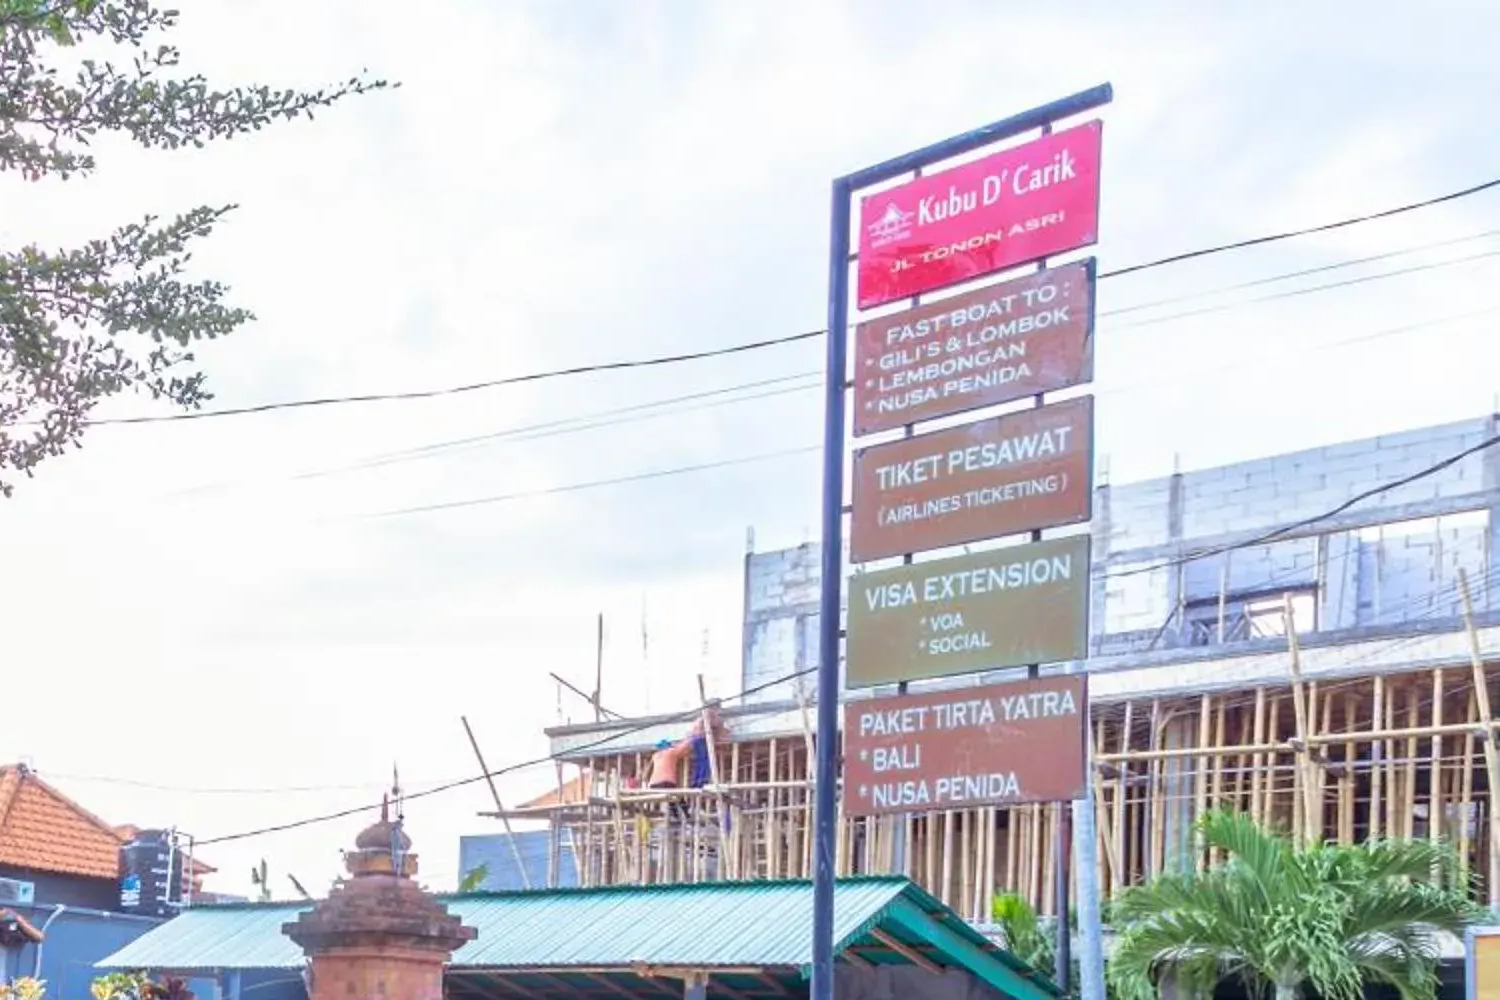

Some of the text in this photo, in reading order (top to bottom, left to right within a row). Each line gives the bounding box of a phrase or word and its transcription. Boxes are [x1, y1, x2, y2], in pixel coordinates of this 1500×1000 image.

[918, 186, 976, 227] Kubu
[1012, 150, 1076, 196] Carik
[921, 230, 1002, 264] TONON
[1007, 211, 1065, 237] ASRI
[879, 306, 1069, 369] GILI'S & LOMBOK
[887, 311, 950, 344] FAST
[951, 295, 1014, 327] BOAT
[879, 342, 1026, 392] LEMBONGAN
[879, 363, 1032, 413] NUSA PENIDA
[876, 427, 1070, 491] TIKET PESAWAT
[866, 555, 1070, 611] VISA EXTENSION
[929, 633, 991, 655] SOCIAL
[930, 613, 964, 632] VOA
[860, 690, 1075, 736] PAKET TIRTA YATRA
[873, 743, 920, 772] BALI
[872, 772, 1019, 807] NUSA PENIDA
